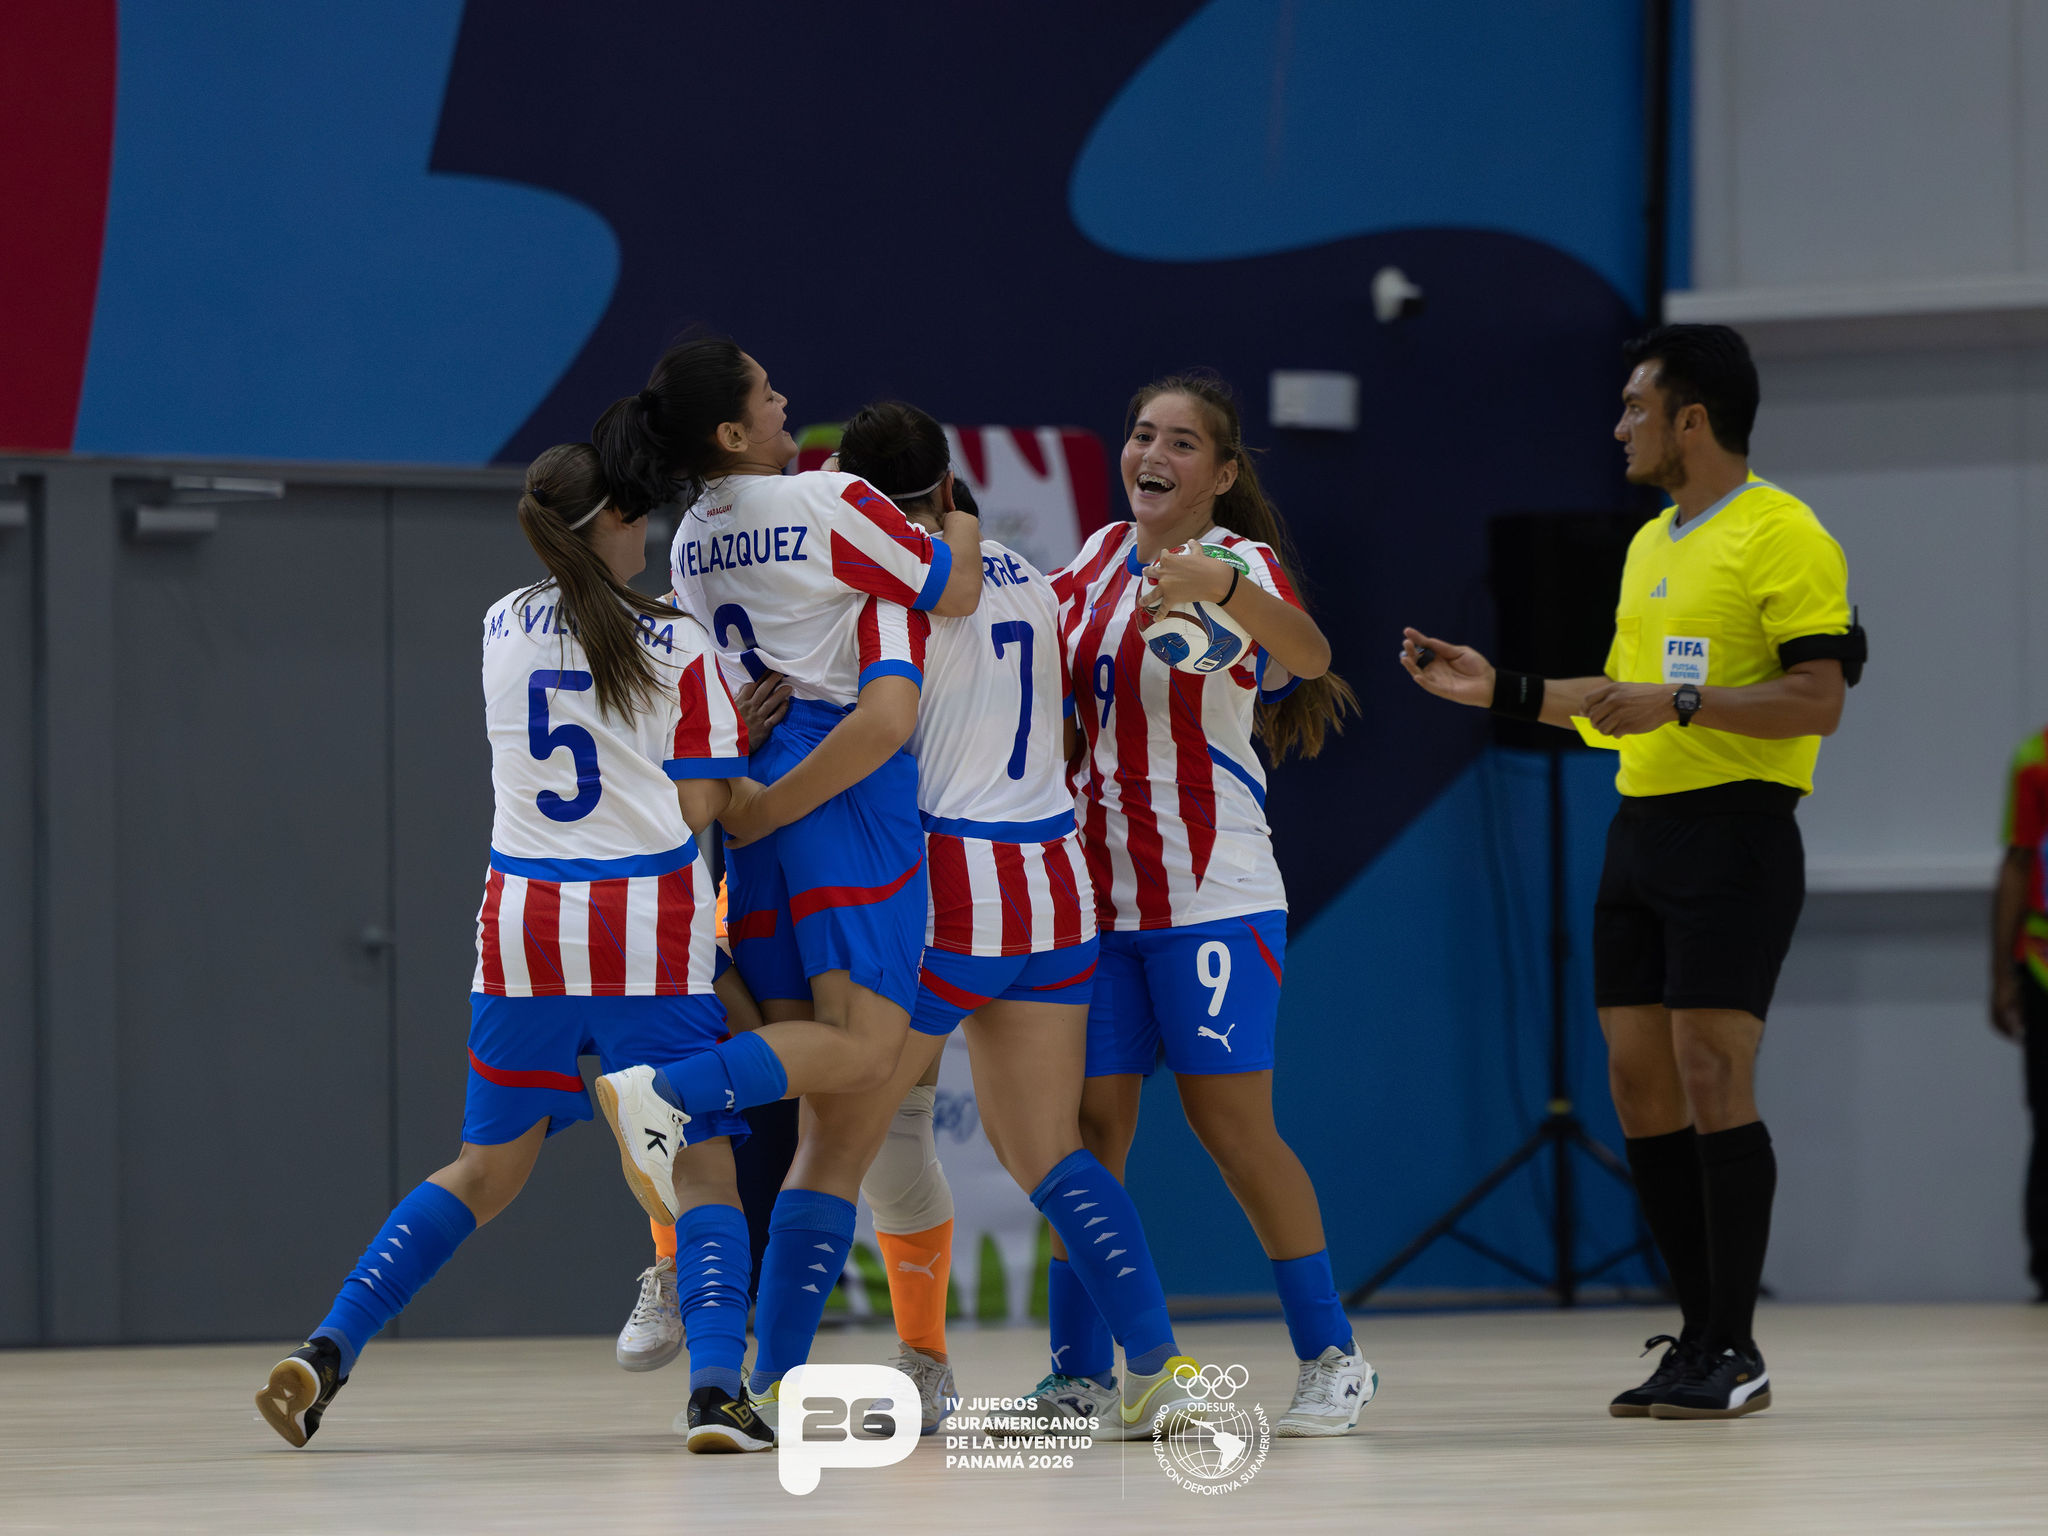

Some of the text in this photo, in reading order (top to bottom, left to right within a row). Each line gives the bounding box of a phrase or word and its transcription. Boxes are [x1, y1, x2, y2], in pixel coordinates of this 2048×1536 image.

[706, 503, 733, 518] PARAGUAY
[677, 526, 808, 579] VELAZQUEZ
[1668, 640, 1704, 657] FIFA
[991, 620, 1034, 780] 7
[1093, 654, 1115, 728] 9
[528, 669, 602, 822] 5
[1196, 940, 1232, 1017] 9
